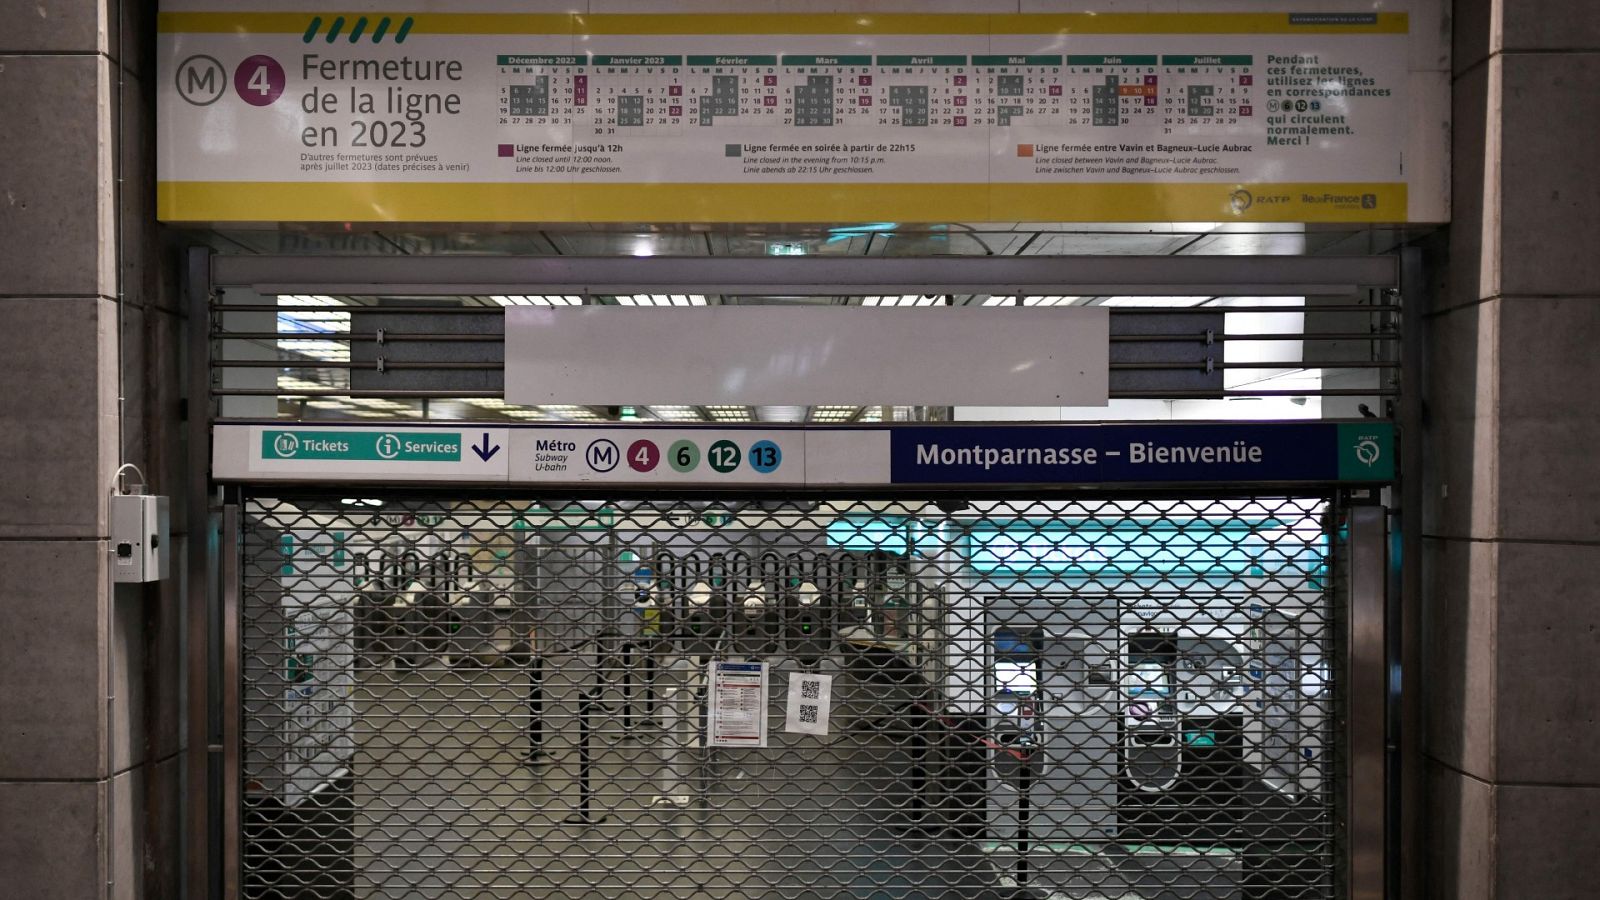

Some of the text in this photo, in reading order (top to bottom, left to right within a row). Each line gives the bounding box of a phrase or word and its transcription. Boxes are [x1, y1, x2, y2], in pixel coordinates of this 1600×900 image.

[1267, 55, 1319, 65] Pendant
[302, 54, 462, 81] Fermeture
[1267, 65, 1363, 76] ces fermetures,
[187, 65, 271, 96] M 4
[1267, 76, 1312, 86] utilisez
[1340, 76, 1375, 88] lignes
[1267, 87, 1391, 98] en correspondances
[301, 87, 461, 121] de la ligne
[1267, 114, 1345, 126] qui circulent
[301, 120, 426, 148] en 2023
[1267, 125, 1354, 135] normalement.
[1267, 136, 1301, 145] Merci
[516, 144, 623, 154] Ligne fermée jusqu'à 12h
[744, 144, 766, 153] Ligne
[769, 144, 799, 152] fermée
[814, 144, 840, 152] soirée
[851, 144, 874, 154] partir
[877, 144, 887, 152] de
[890, 144, 915, 152] 22h15
[1036, 144, 1059, 153] Ligne
[1061, 144, 1092, 152] fermée
[1119, 144, 1143, 152] Vavin
[1222, 144, 1253, 152] Aubrac
[300, 153, 438, 164] D'autres fermetures sont prévues
[744, 156, 758, 164] Line
[760, 156, 781, 164] closed
[791, 156, 802, 164] the
[804, 157, 830, 165] evening
[831, 156, 849, 164] from
[1035, 156, 1050, 164] Line
[1052, 156, 1073, 164] closed
[1075, 156, 1103, 164] between
[300, 163, 323, 172] après
[325, 163, 348, 172] juillet
[352, 163, 372, 171] 2023
[375, 162, 400, 172] (dates
[403, 162, 436, 172] précises
[446, 162, 470, 172] venir)
[762, 166, 784, 174] abends
[786, 166, 796, 174] ab
[798, 166, 817, 174] 22:15
[819, 166, 832, 174] Uhr
[303, 439, 349, 452] Tickets
[404, 441, 458, 453] Services
[536, 440, 576, 451] Métro
[535, 453, 568, 464] Subway
[593, 446, 777, 466] M 4 6 12 13
[916, 443, 1098, 469] Montparnasse
[1129, 442, 1263, 464] Bienvenüe
[535, 463, 567, 472] U-bahn
